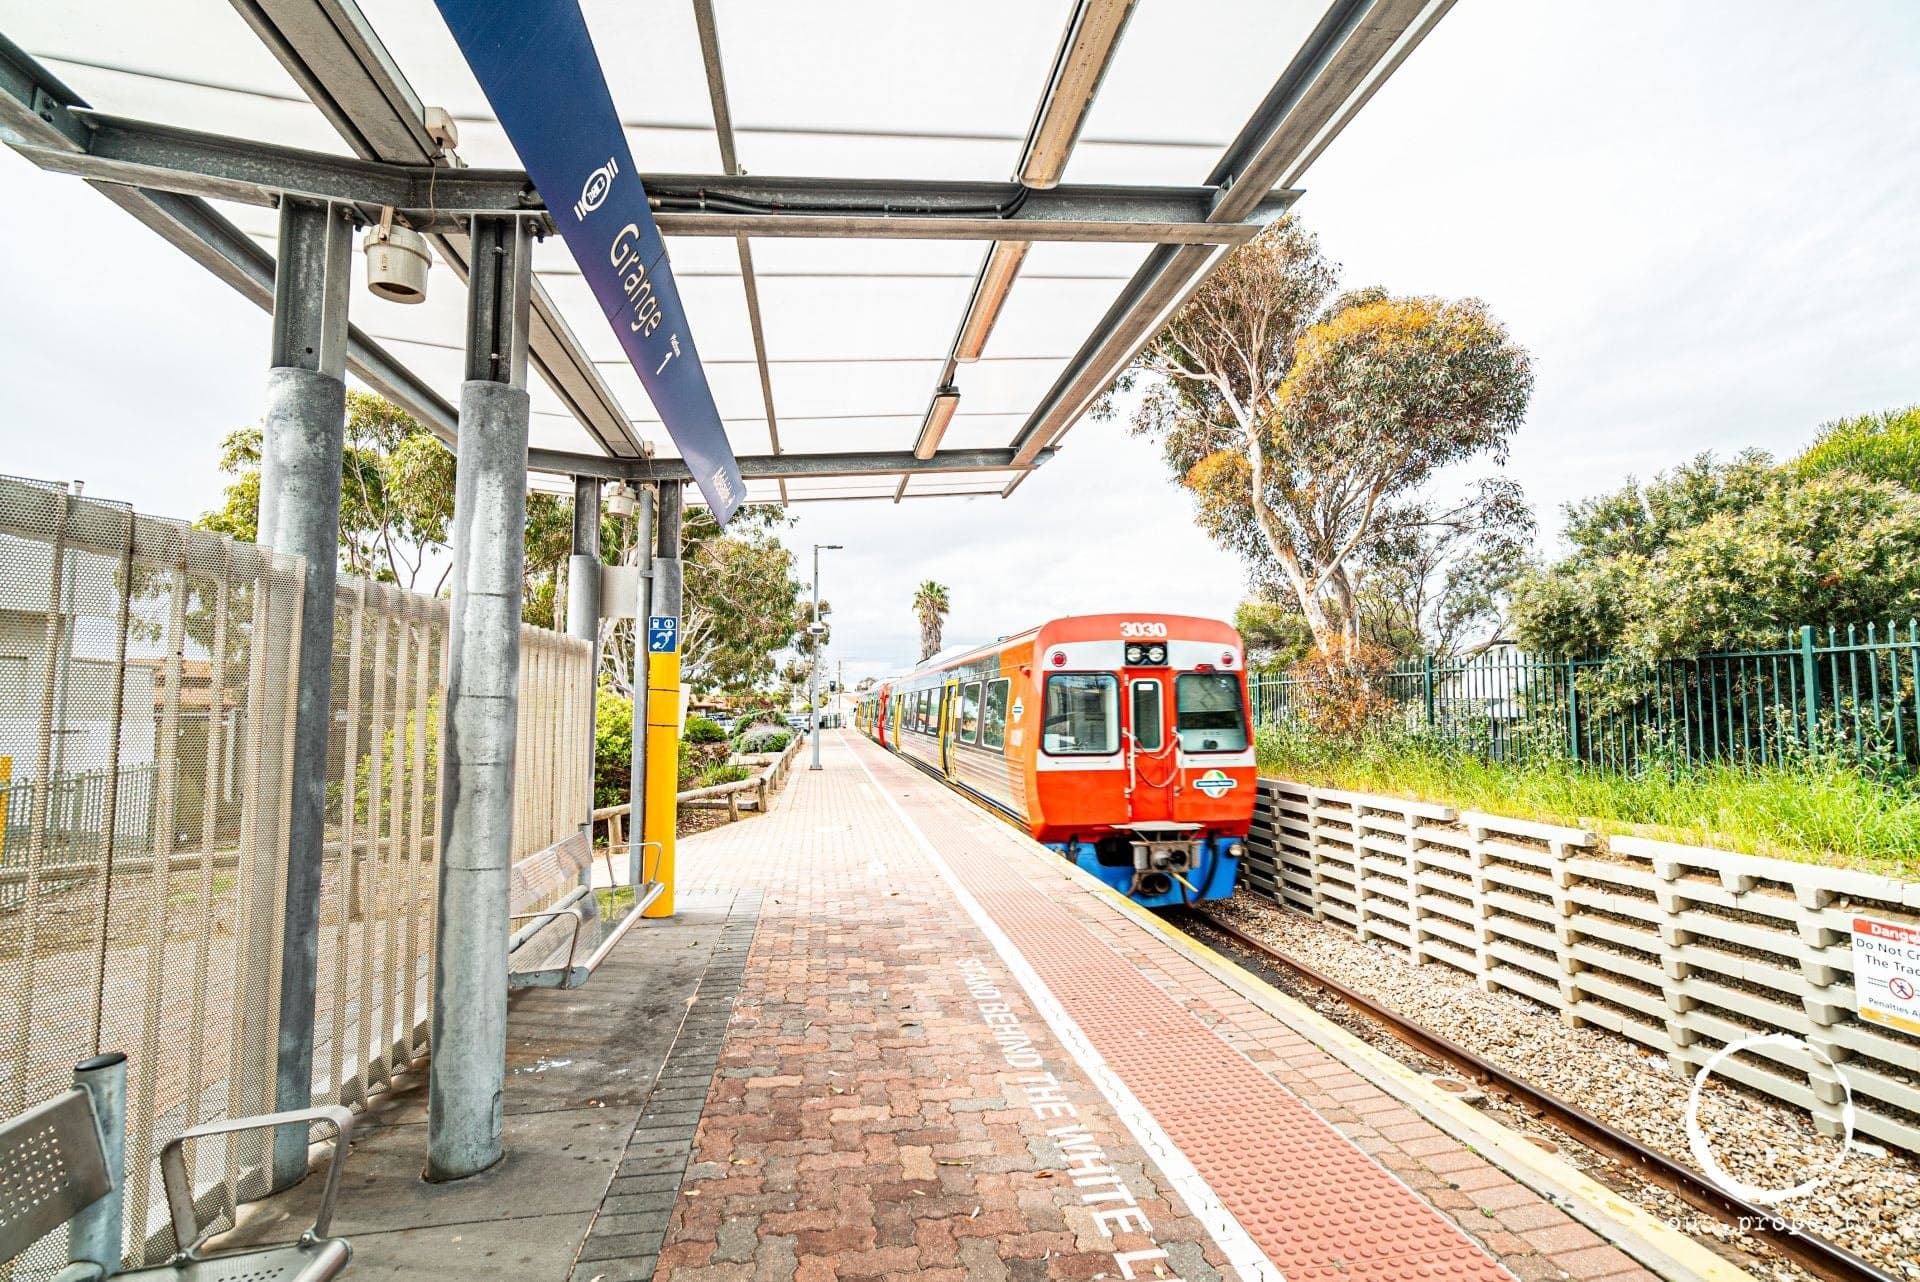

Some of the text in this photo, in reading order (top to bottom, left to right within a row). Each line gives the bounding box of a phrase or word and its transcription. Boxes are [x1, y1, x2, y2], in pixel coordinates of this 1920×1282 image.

[610, 223, 663, 337] Grange
[656, 352, 673, 375] 1
[1120, 622, 1168, 637] 3030
[1856, 938, 1874, 950] Do
[1878, 943, 1902, 957] Not
[1865, 954, 1889, 968] The
[1868, 997, 1909, 1015] Penalties
[956, 958, 1180, 1282] STAND BEHIND THE WHITE L
